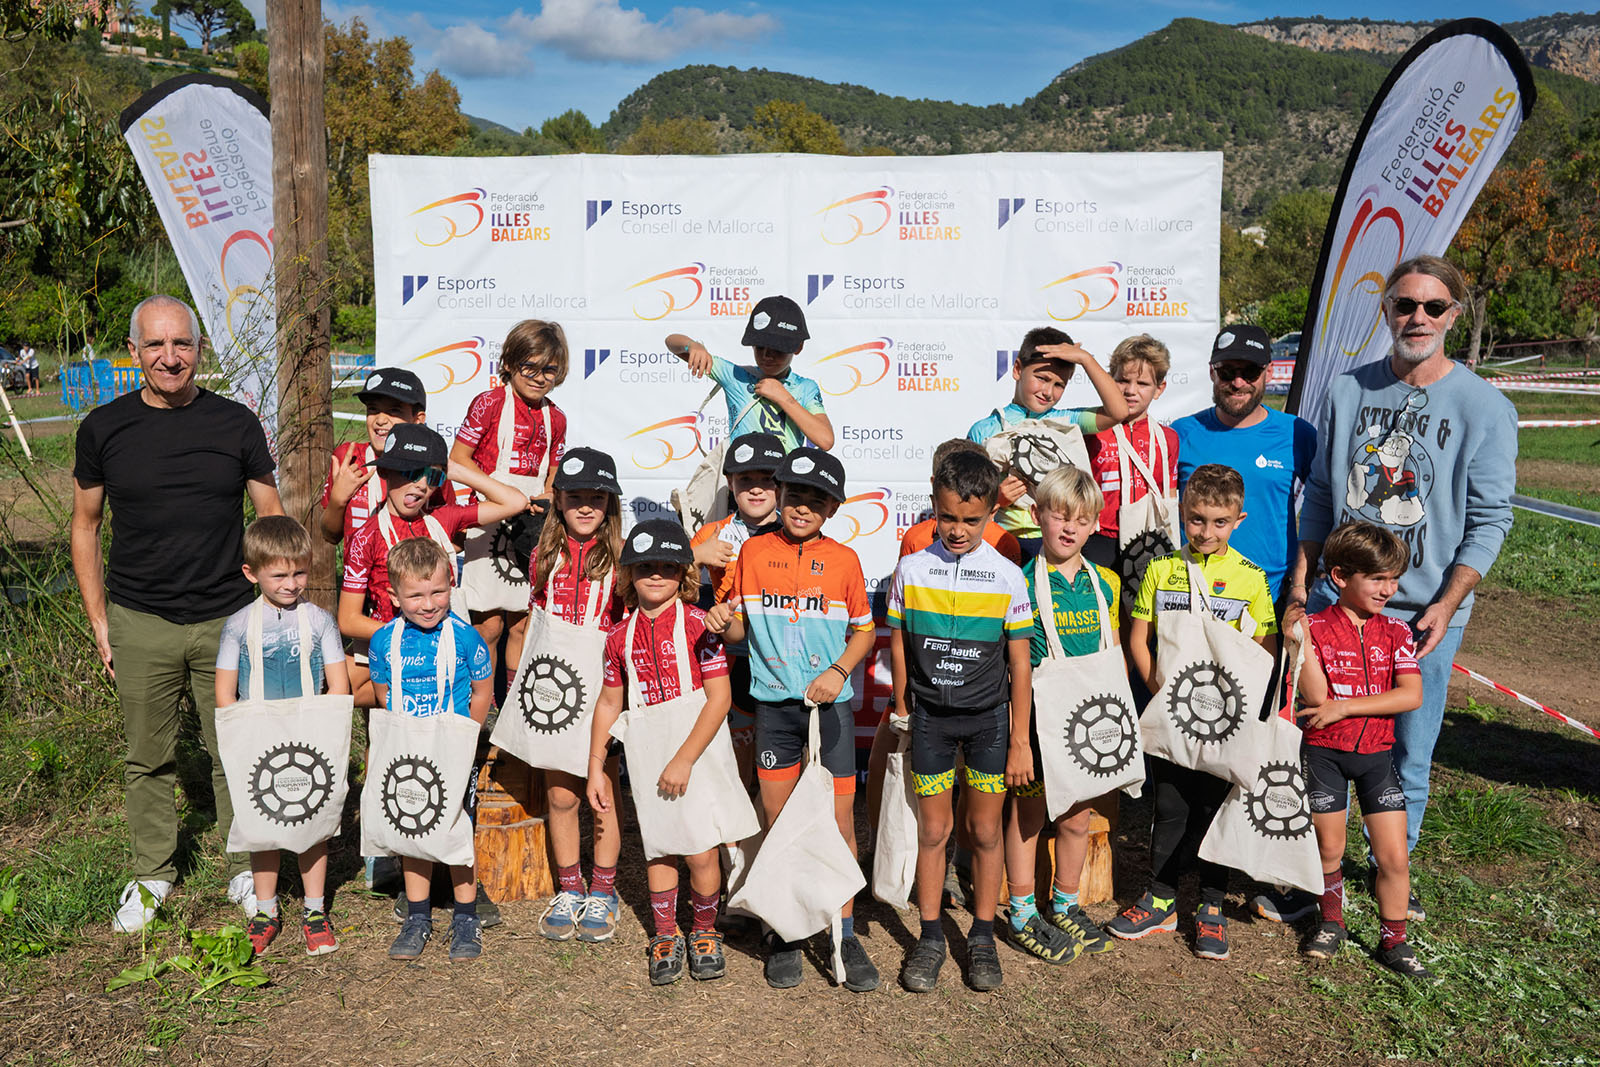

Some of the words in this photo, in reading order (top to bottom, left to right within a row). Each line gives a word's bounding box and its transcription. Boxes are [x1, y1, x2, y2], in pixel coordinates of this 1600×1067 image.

[1381, 86, 1444, 183] Federació
[1395, 169, 1413, 191] de
[1411, 79, 1466, 161] Ciclisme
[1422, 86, 1516, 218] BALEARS
[1405, 118, 1466, 205] ILLES
[491, 191, 539, 202] Federació
[899, 190, 948, 201] Federació
[491, 203, 502, 211] de
[505, 202, 545, 211] Ciclisme
[622, 201, 682, 218] Esports
[899, 201, 911, 210] de
[914, 201, 955, 210] Ciclisme
[1035, 199, 1097, 217] Esports
[491, 213, 531, 227] ILLES
[899, 211, 939, 225] ILLES
[1034, 217, 1096, 233] Consell
[1099, 217, 1120, 233] de
[1124, 216, 1193, 233] Mallorca
[621, 220, 677, 234] Consell
[682, 220, 703, 234] de
[707, 220, 774, 234] Mallorca
[899, 226, 962, 241] BALEARS
[491, 227, 551, 242] BALEARS
[709, 266, 758, 276] Federació
[1126, 266, 1175, 276] Federació
[437, 276, 496, 292] Esports
[709, 277, 721, 286] de
[725, 277, 765, 286] Ciclisme
[843, 275, 905, 292] Esports
[1126, 276, 1139, 286] de
[1141, 276, 1183, 286] Ciclisme
[437, 294, 491, 309] Consell
[497, 294, 516, 309] de
[521, 293, 587, 309] Mallorca
[710, 287, 750, 301] ILLES
[1127, 287, 1167, 301] ILLES
[843, 294, 903, 309] Consell
[906, 294, 926, 309] de
[932, 294, 999, 310] Mallorca
[1126, 302, 1188, 317] BALEARS
[897, 341, 946, 352] Federació
[620, 350, 680, 367] Esports
[897, 352, 909, 361] de
[912, 352, 954, 361] Ciclisme
[620, 368, 676, 383] Consell
[897, 363, 938, 376] ILLES
[897, 377, 960, 392] BALEARS
[708, 426, 721, 435] de
[842, 426, 904, 444] Esports
[1437, 418, 1452, 450] &
[842, 445, 899, 460] Consell
[905, 445, 924, 460] de
[620, 499, 678, 516] Esport
[896, 502, 908, 511] de
[565, 603, 585, 614] ALO
[936, 660, 963, 673] Jeep
[649, 676, 676, 690] ALOU
